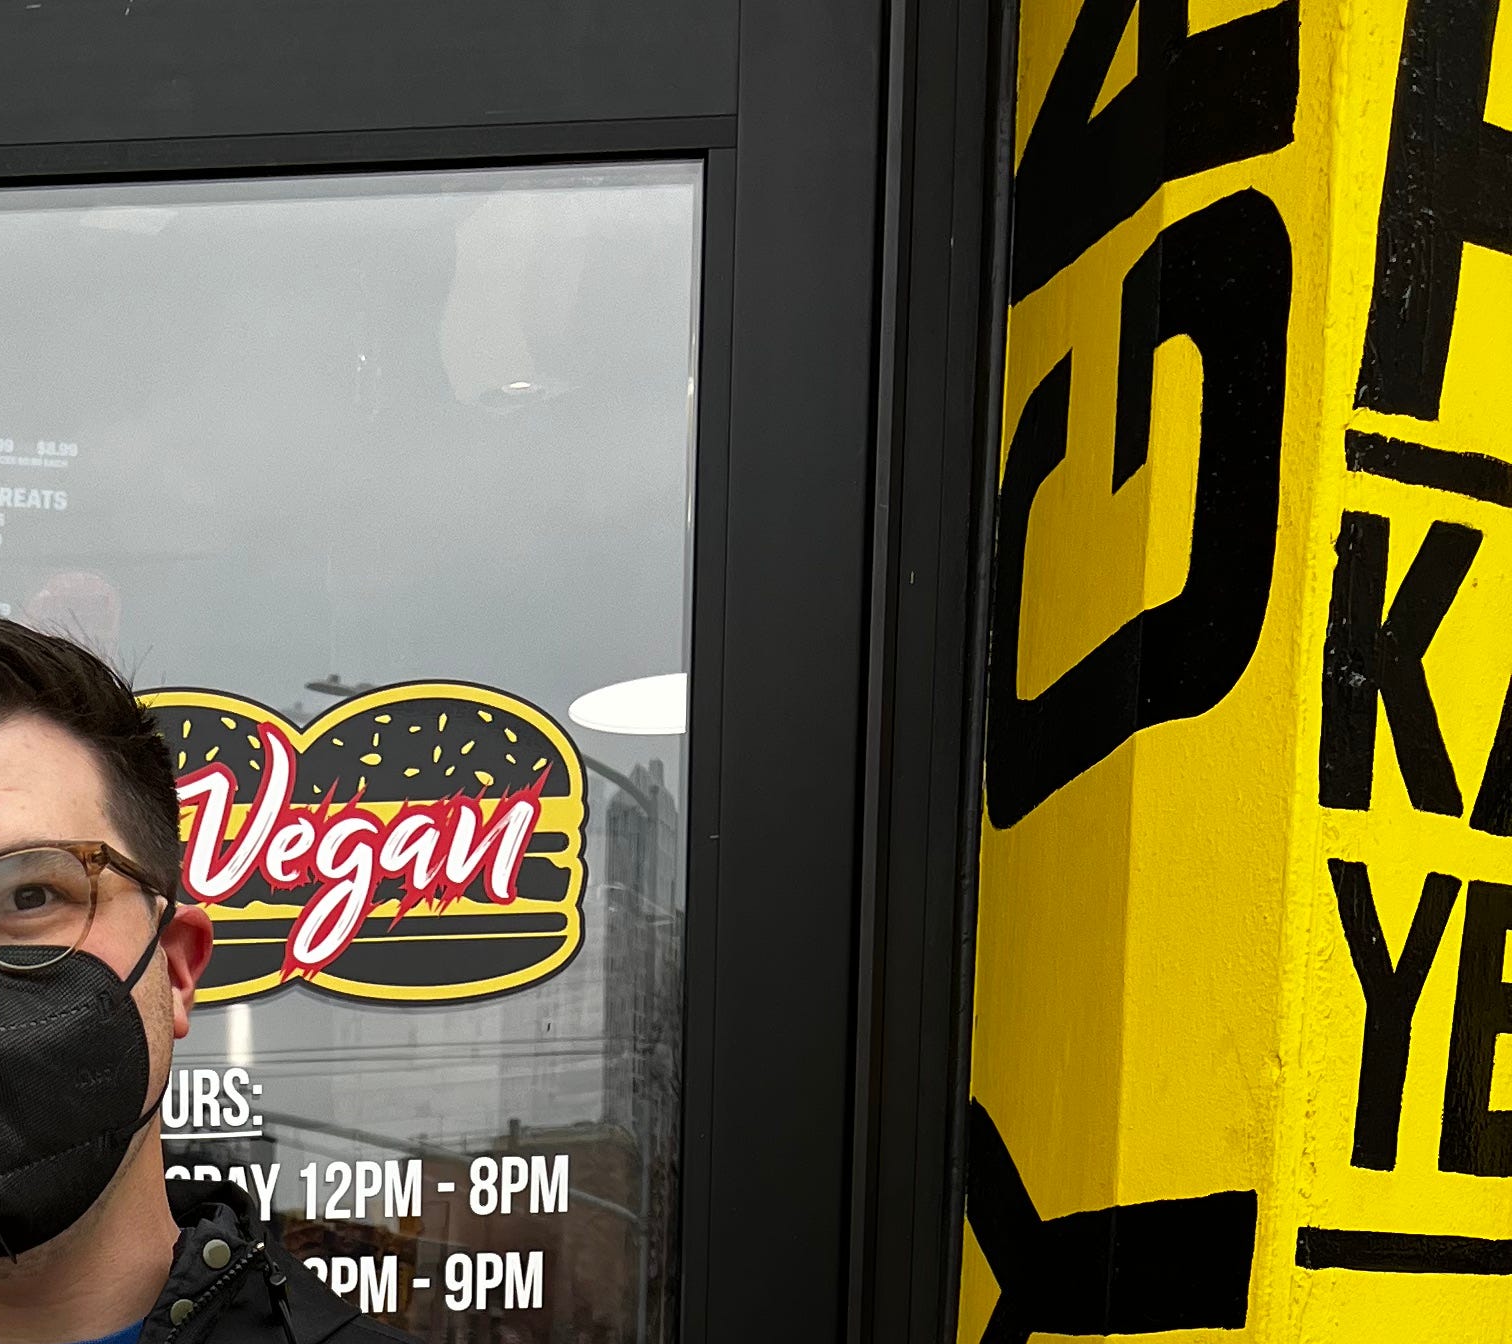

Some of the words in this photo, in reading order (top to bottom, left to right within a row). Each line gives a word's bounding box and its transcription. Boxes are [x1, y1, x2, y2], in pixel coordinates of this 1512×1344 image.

[176, 728, 538, 968] Vegan
[161, 1066, 263, 1130] URS:
[300, 1159, 423, 1221] 12PM
[469, 1154, 570, 1217] 8PM
[444, 1251, 544, 1312] 9PM
